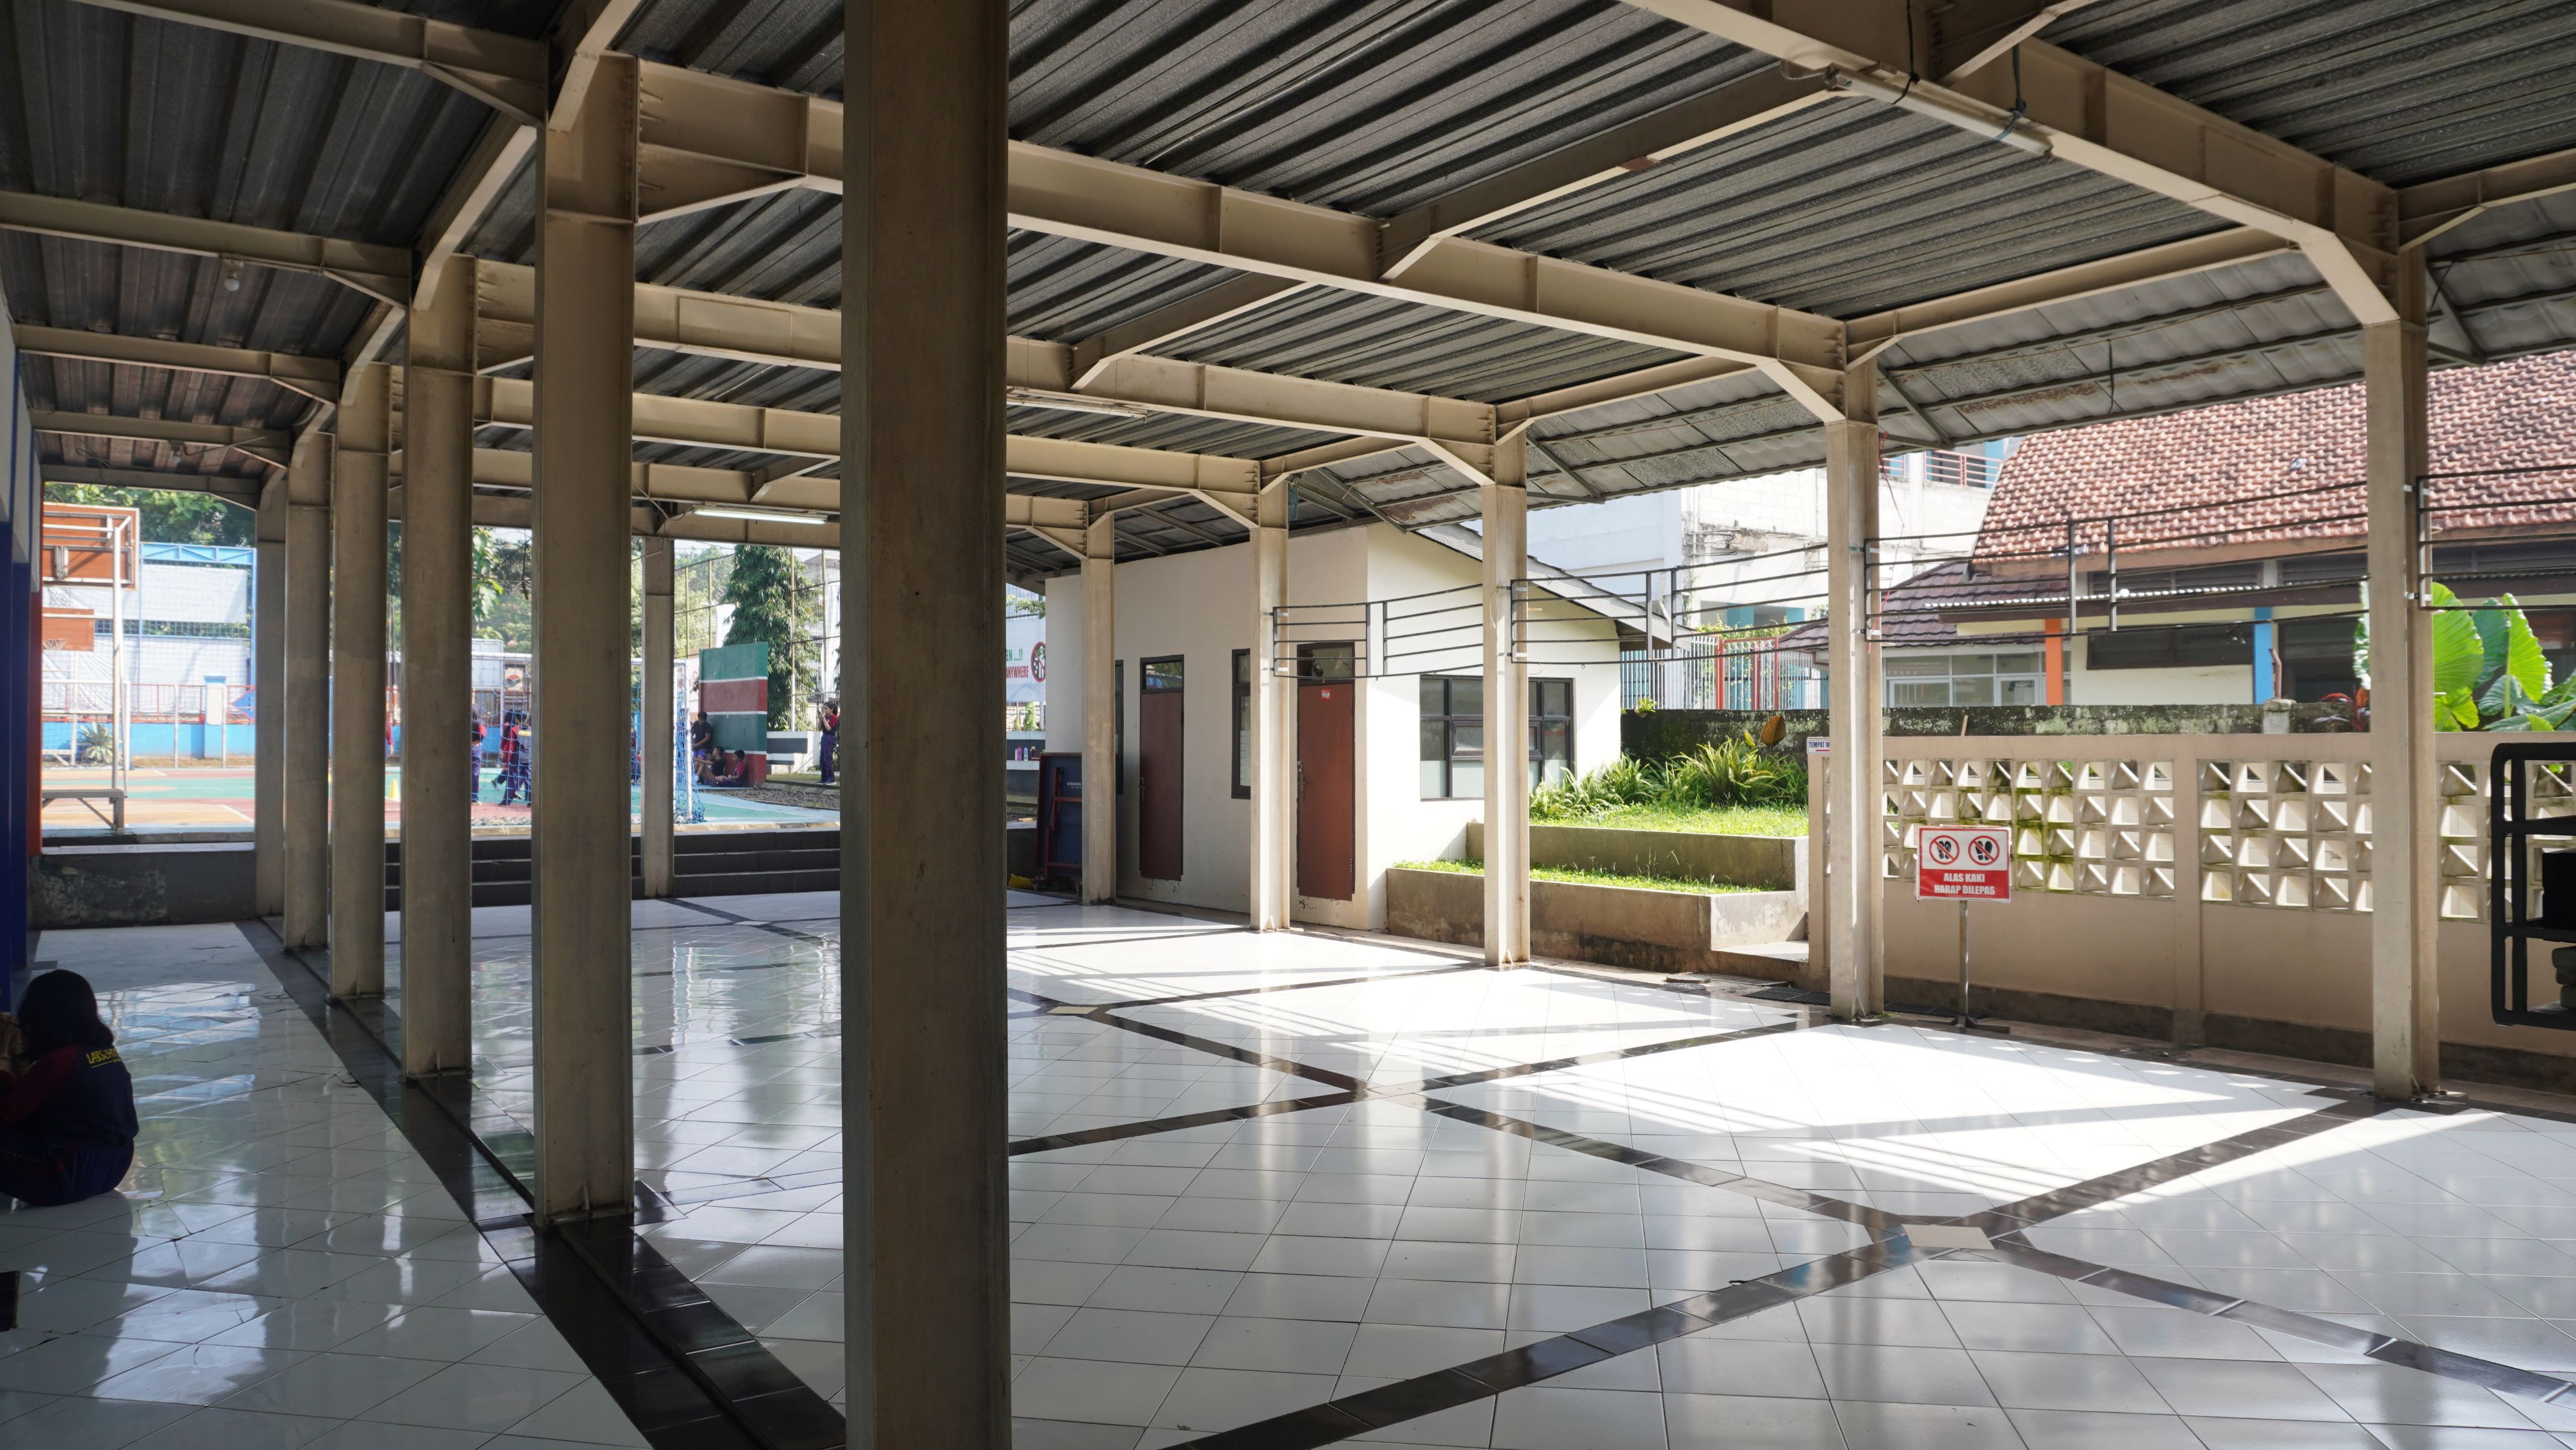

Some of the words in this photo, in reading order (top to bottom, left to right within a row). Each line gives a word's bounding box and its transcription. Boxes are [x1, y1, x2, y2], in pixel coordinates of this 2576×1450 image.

[1006, 666, 1028, 678] ANYWHERE
[1943, 873, 1963, 882] ALAS
[1965, 873, 1985, 882] KAKI
[1934, 885, 1961, 894] HARAP
[1963, 885, 1995, 894] DILEPAS
